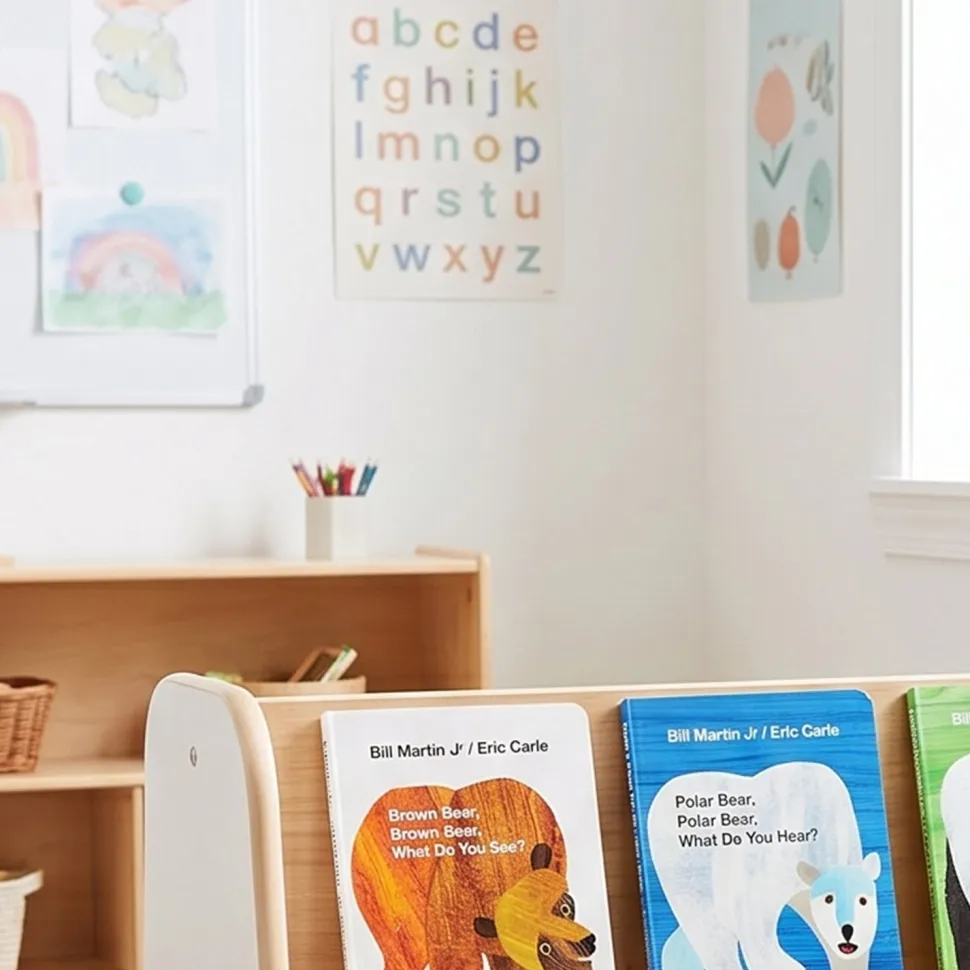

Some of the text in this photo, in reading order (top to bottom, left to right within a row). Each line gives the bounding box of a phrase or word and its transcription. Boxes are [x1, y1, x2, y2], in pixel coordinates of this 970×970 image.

[667, 729, 690, 743] Bill
[693, 728, 740, 742] Martin
[744, 727, 757, 740] Jr
[370, 745, 393, 759] Bill
[397, 744, 445, 758] Martin
[450, 743, 463, 756] Jr
[477, 741, 506, 755] Eric
[509, 739, 549, 753] Carle
[675, 794, 714, 809] Polar
[388, 808, 438, 822] Brown
[677, 814, 716, 828] Polar
[390, 827, 440, 841] Brown
[678, 828, 819, 847] What Do You Hear?
[434, 843, 455, 857] Do
[458, 842, 486, 855] You
[489, 839, 526, 854] See?
